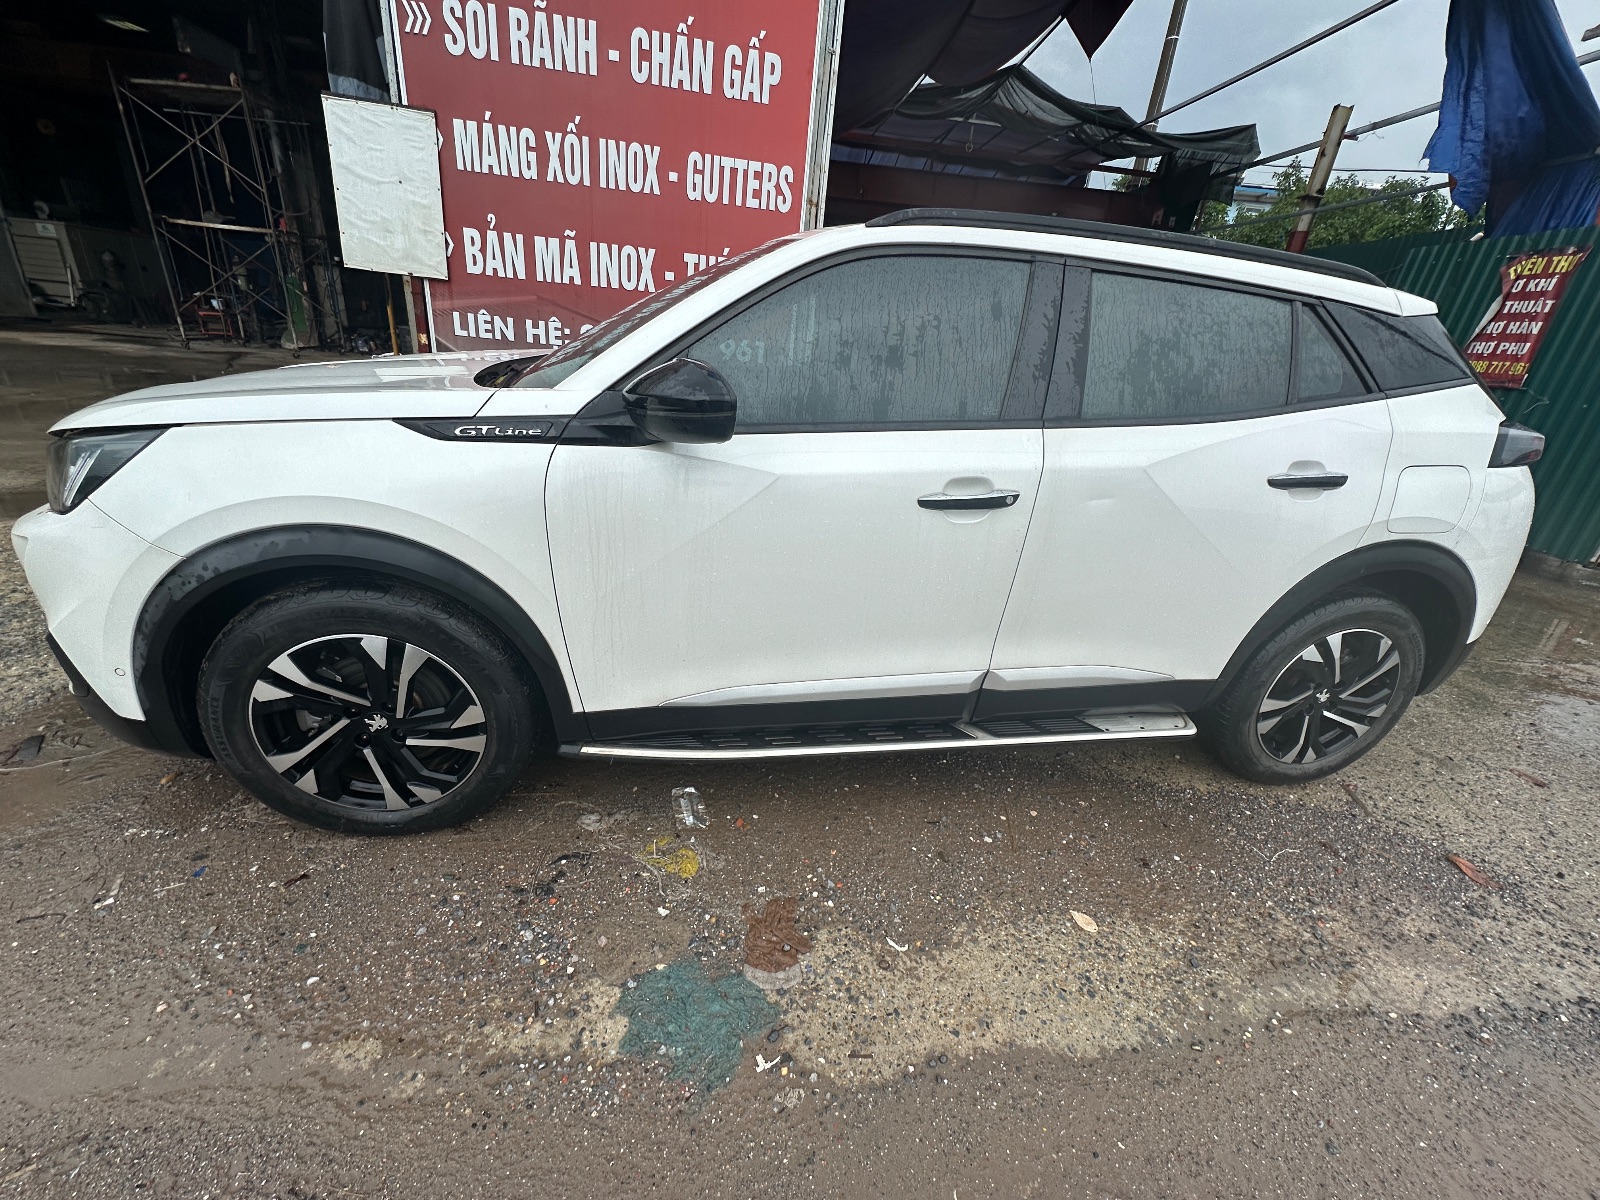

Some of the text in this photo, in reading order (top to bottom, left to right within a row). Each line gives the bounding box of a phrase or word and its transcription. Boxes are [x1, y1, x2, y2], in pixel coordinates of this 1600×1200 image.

[443, 0, 782, 105] SOI RÃNH - CHẤN GẤP
[452, 111, 794, 213] MÁNG XỐI INOX - GUTTERS
[462, 213, 526, 280] BẢN
[534, 229, 582, 285] MÃ
[590, 241, 656, 293] INOX
[664, 271, 675, 281] -
[1512, 275, 1561, 293] Ơ KHÍ
[1502, 297, 1555, 316] THUẬT
[452, 309, 515, 342] LIÊN
[1483, 318, 1544, 336] HỢ HÀN
[1467, 340, 1532, 358] THỢ PHỤ
[1488, 361, 1511, 374] 717
